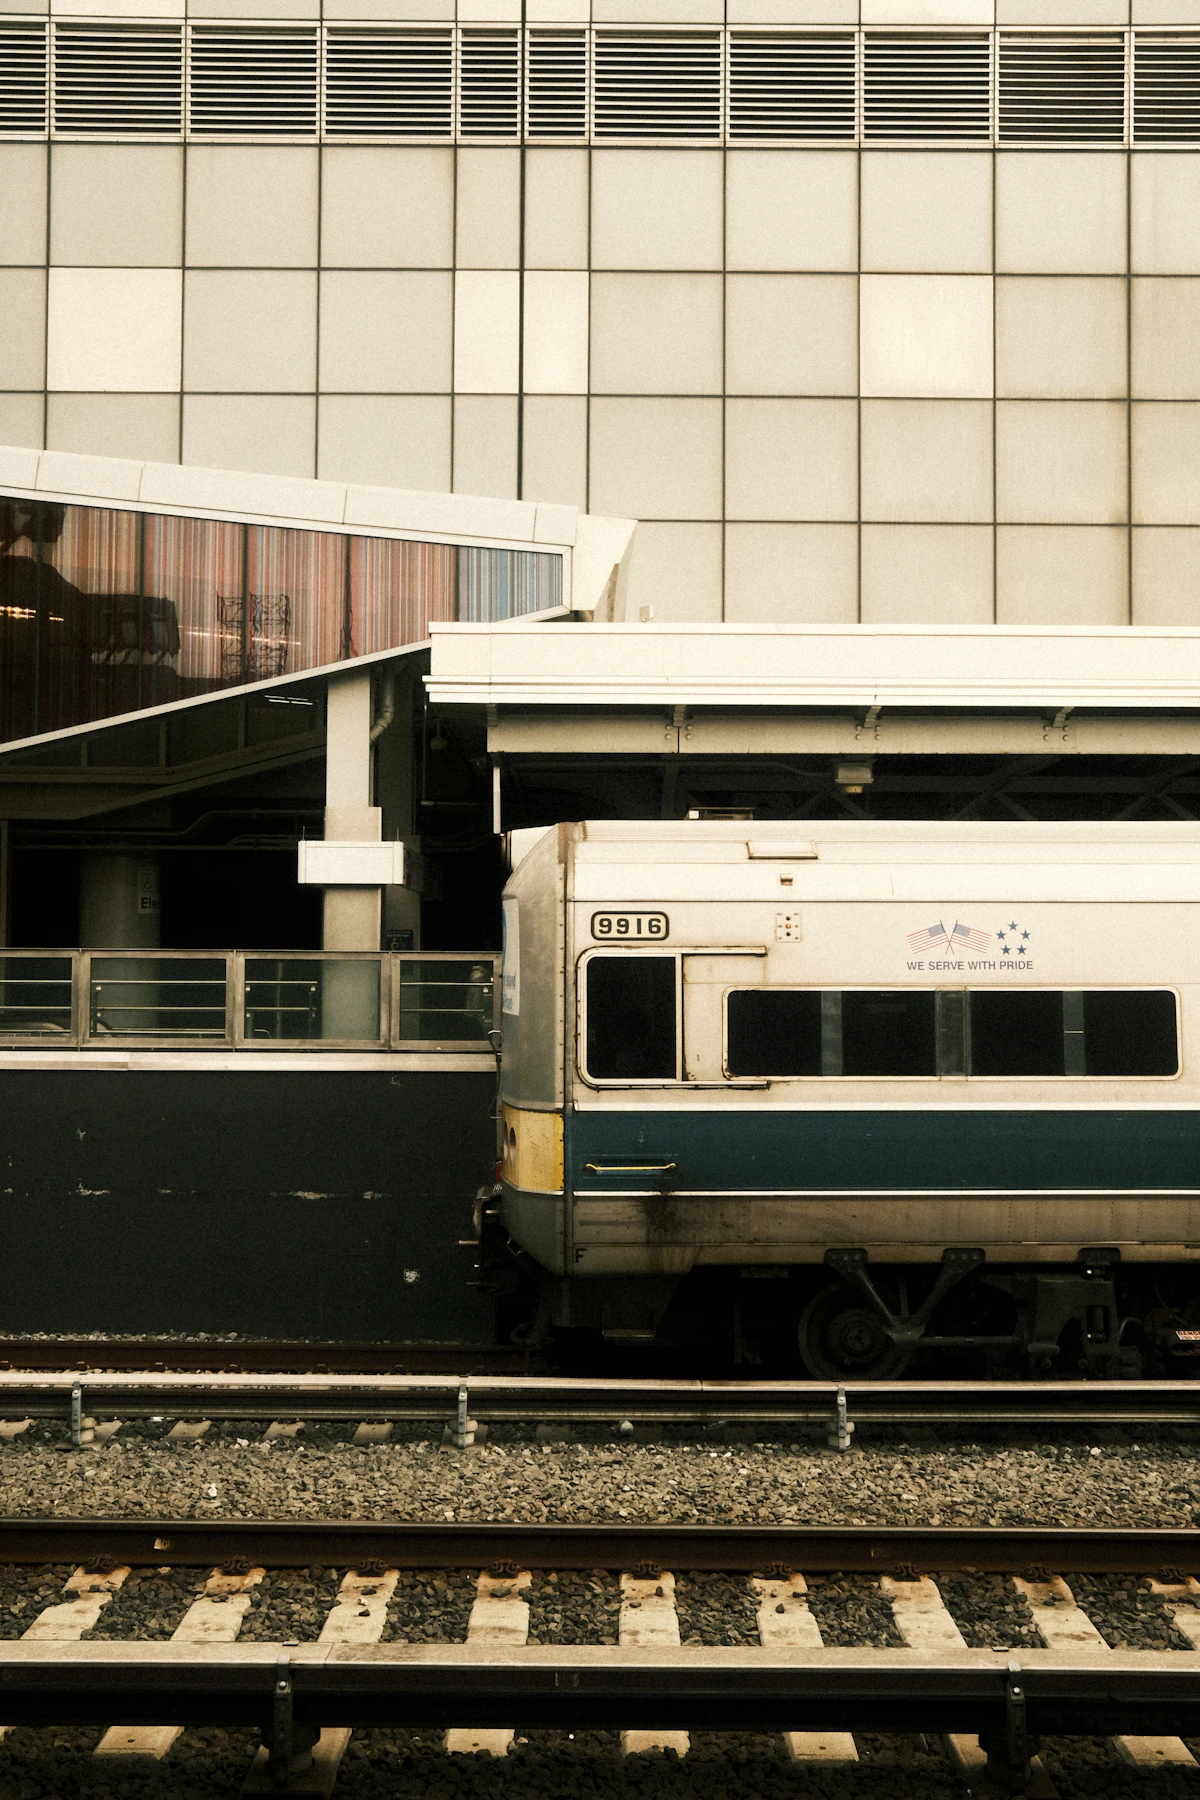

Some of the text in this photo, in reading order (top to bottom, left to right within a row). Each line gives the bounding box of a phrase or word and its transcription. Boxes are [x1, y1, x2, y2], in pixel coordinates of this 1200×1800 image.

[141, 897, 159, 909] Ele
[598, 918, 662, 934] 9916
[906, 960, 1034, 971] WE SERVE WITH PRIDE
[575, 1248, 588, 1263] F
